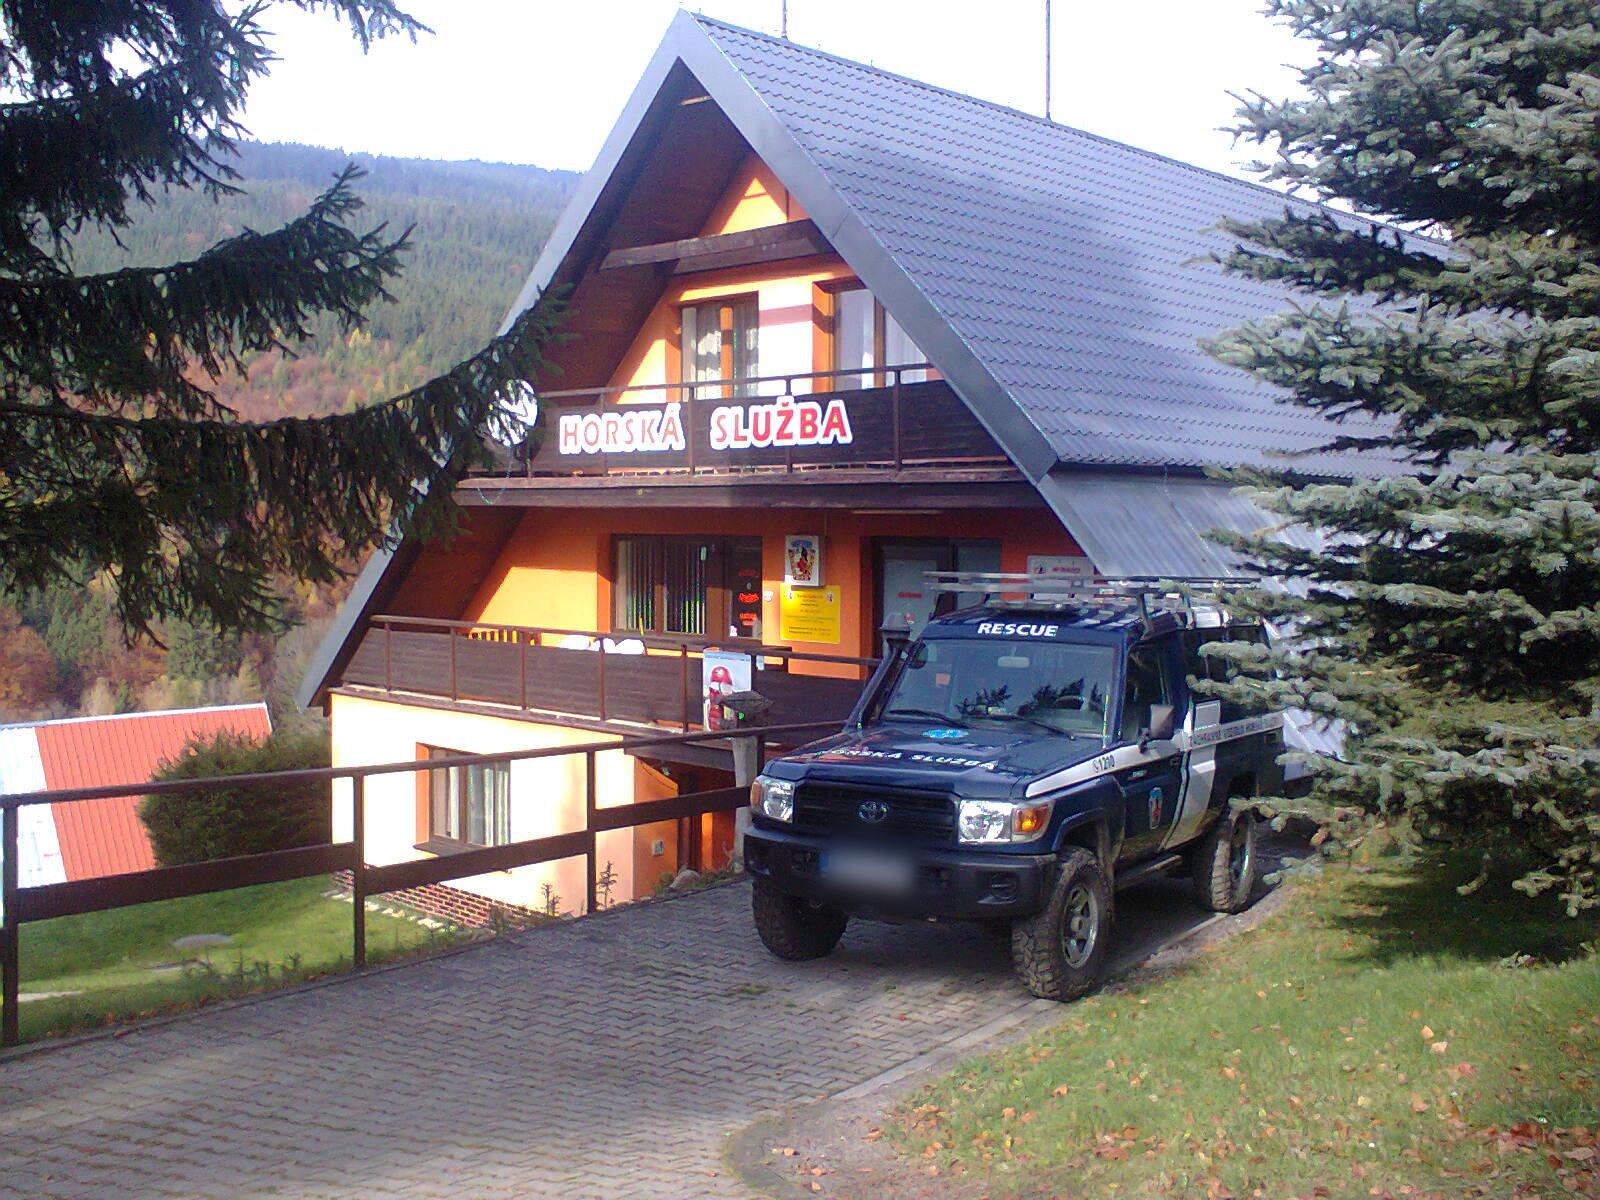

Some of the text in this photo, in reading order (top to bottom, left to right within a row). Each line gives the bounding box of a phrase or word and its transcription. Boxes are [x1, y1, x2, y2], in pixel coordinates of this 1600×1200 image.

[561, 399, 850, 452] HORSKÁ SLUŽBA
[977, 622, 1058, 637] RESCUE
